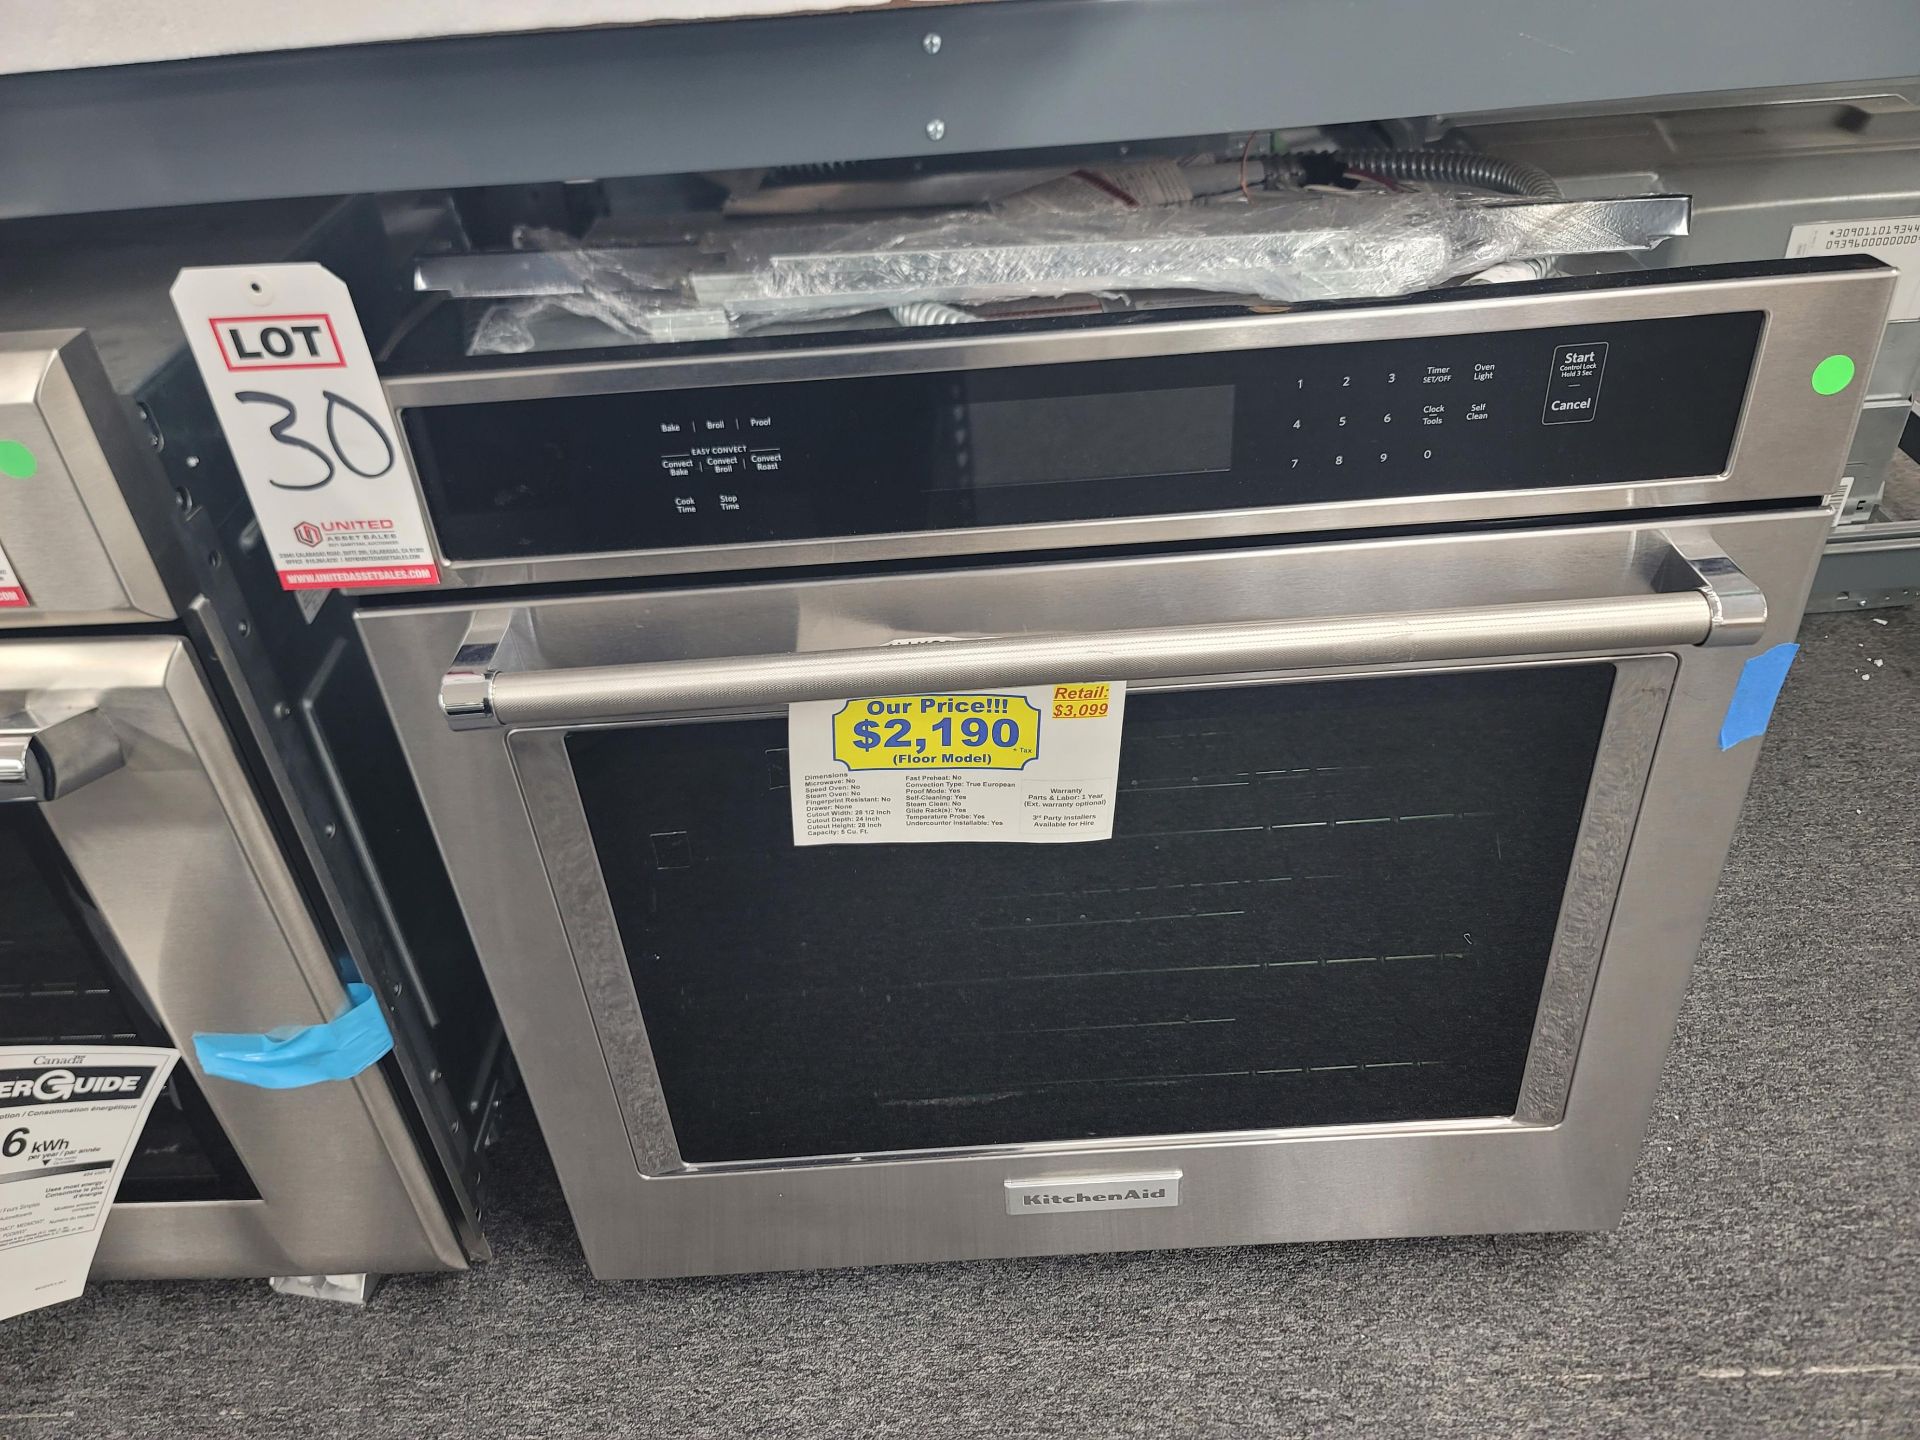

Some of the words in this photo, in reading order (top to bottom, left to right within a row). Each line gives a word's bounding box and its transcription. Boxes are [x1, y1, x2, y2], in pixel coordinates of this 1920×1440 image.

[229, 326, 321, 359] LOT
[1565, 351, 1595, 364] Start
[1427, 366, 1450, 375] Timer
[1474, 363, 1495, 372] Oven
[1560, 363, 1582, 371] Control
[1388, 372, 1396, 384] 3
[1422, 374, 1452, 384] SET/OFF
[1473, 371, 1494, 381] Light
[1297, 379, 1303, 389] 1
[1342, 376, 1350, 387] 2
[1423, 404, 1445, 414] Clock
[1470, 403, 1487, 412] Self
[1551, 397, 1591, 411] Cancel
[1339, 416, 1346, 427] 5
[1383, 413, 1391, 424] 6
[1422, 417, 1443, 425] Tools
[1466, 412, 1488, 421] Clean
[706, 420, 725, 430] Broil
[750, 417, 771, 427] Proof
[1293, 419, 1301, 430] 4
[661, 423, 681, 433] Bake
[235, 390, 395, 491] 30
[691, 448, 710, 456] EASY
[712, 445, 747, 455] CONVECT
[1423, 449, 1432, 460] 0
[707, 457, 738, 466] Convect
[751, 453, 782, 463] Convect
[1335, 455, 1343, 466] 8
[1380, 452, 1387, 463] 9
[662, 460, 694, 469] Convect
[757, 462, 779, 471] Roast
[1291, 458, 1299, 469] 7
[670, 469, 689, 477] Bake
[714, 466, 733, 474] Broil
[675, 497, 695, 506] Cook
[720, 495, 738, 503] Stop
[677, 505, 696, 513] Time
[720, 503, 740, 511] Time
[321, 519, 394, 532] UNITED
[363, 533, 399, 541] SALES
[1053, 685, 1110, 700] Retail:
[867, 700, 912, 716] Our
[920, 698, 1009, 714] Price!!!
[1053, 702, 1109, 719] $3,099
[852, 717, 1020, 755] $2,190
[893, 754, 937, 766] (Floor
[941, 753, 992, 766] Model)
[804, 772, 848, 781] Dimensions
[805, 779, 844, 787] Microwave:
[805, 785, 827, 793] Speed
[1050, 787, 1083, 795] Warranty
[806, 798, 844, 806] Fingerprint
[905, 794, 953, 802] Self-Cleaning:
[1042, 801, 1073, 809] warranty
[1075, 799, 1107, 808] optional)
[831, 816, 854, 824] Depth:
[1043, 814, 1062, 822] Party
[831, 822, 856, 830] Height:
[807, 829, 839, 837] Capacity:
[33, 1055, 85, 1066] Canada
[27, 1107, 89, 1117] Consommation
[2, 1127, 30, 1158] 6
[31, 1137, 70, 1154] kWh
[27, 1153, 41, 1161] per
[42, 1151, 59, 1161] year
[64, 1149, 77, 1158] par
[45, 1184, 62, 1193] Uses
[81, 1180, 104, 1189] energy
[45, 1189, 82, 1199] Consomme
[1022, 1188, 1166, 1206] KitchenAid
